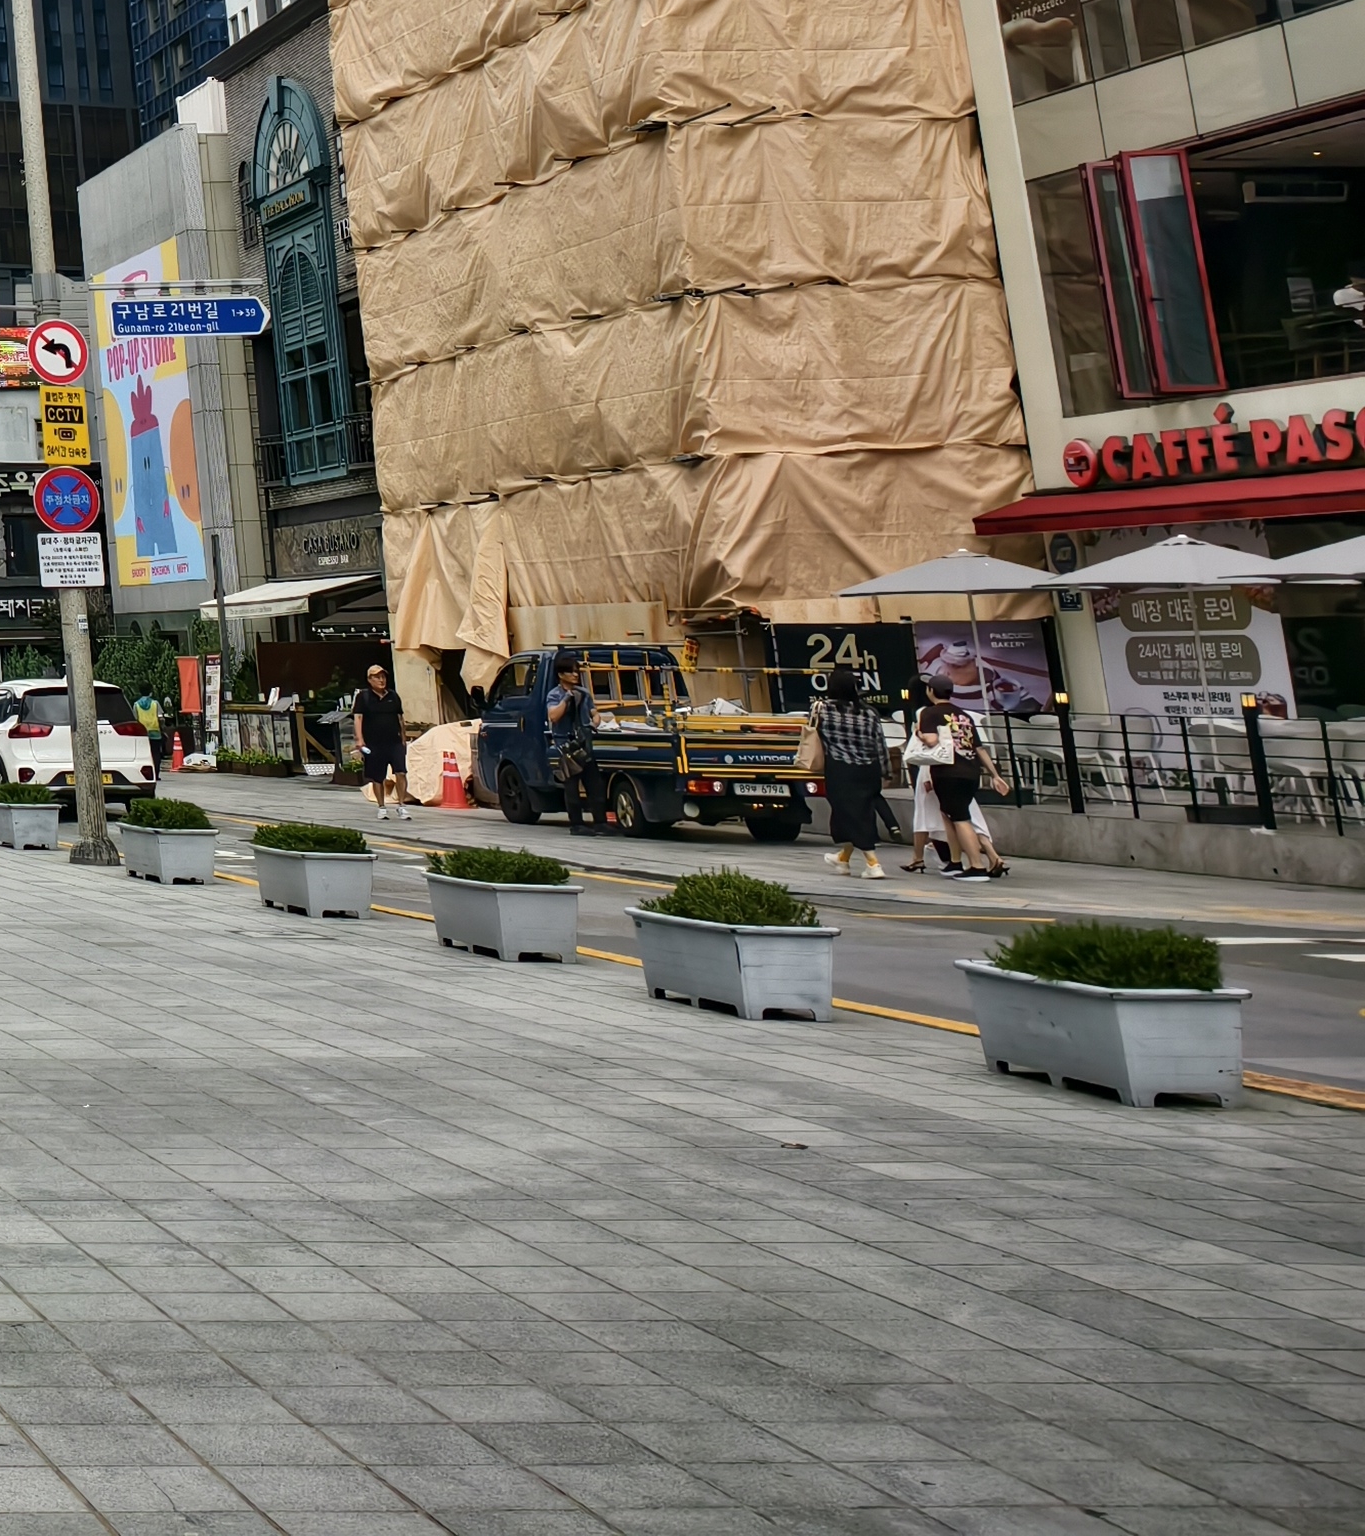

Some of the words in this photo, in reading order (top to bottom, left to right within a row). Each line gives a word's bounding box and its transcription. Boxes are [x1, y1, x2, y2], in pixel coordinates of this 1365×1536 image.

[245, 308, 256, 317] 39
[117, 323, 165, 334] Gunam-ro
[167, 321, 220, 333] 21beon-gil
[106, 338, 140, 383] POP-UP
[141, 336, 177, 370] STORE
[47, 407, 80, 422] CCTV
[46, 445, 67, 458] 24시간
[302, 536, 323, 555] CASA
[324, 532, 360, 553] BUSANO
[340, 554, 350, 564] BAR
[1131, 599, 1162, 624] 매장
[1203, 596, 1237, 622] 문의
[805, 632, 878, 670] 24h
[1137, 642, 1172, 660] 24시간
[1220, 642, 1243, 659] 문의
[738, 754, 792, 762] HYUNDAI
[760, 783, 785, 795] 6794
